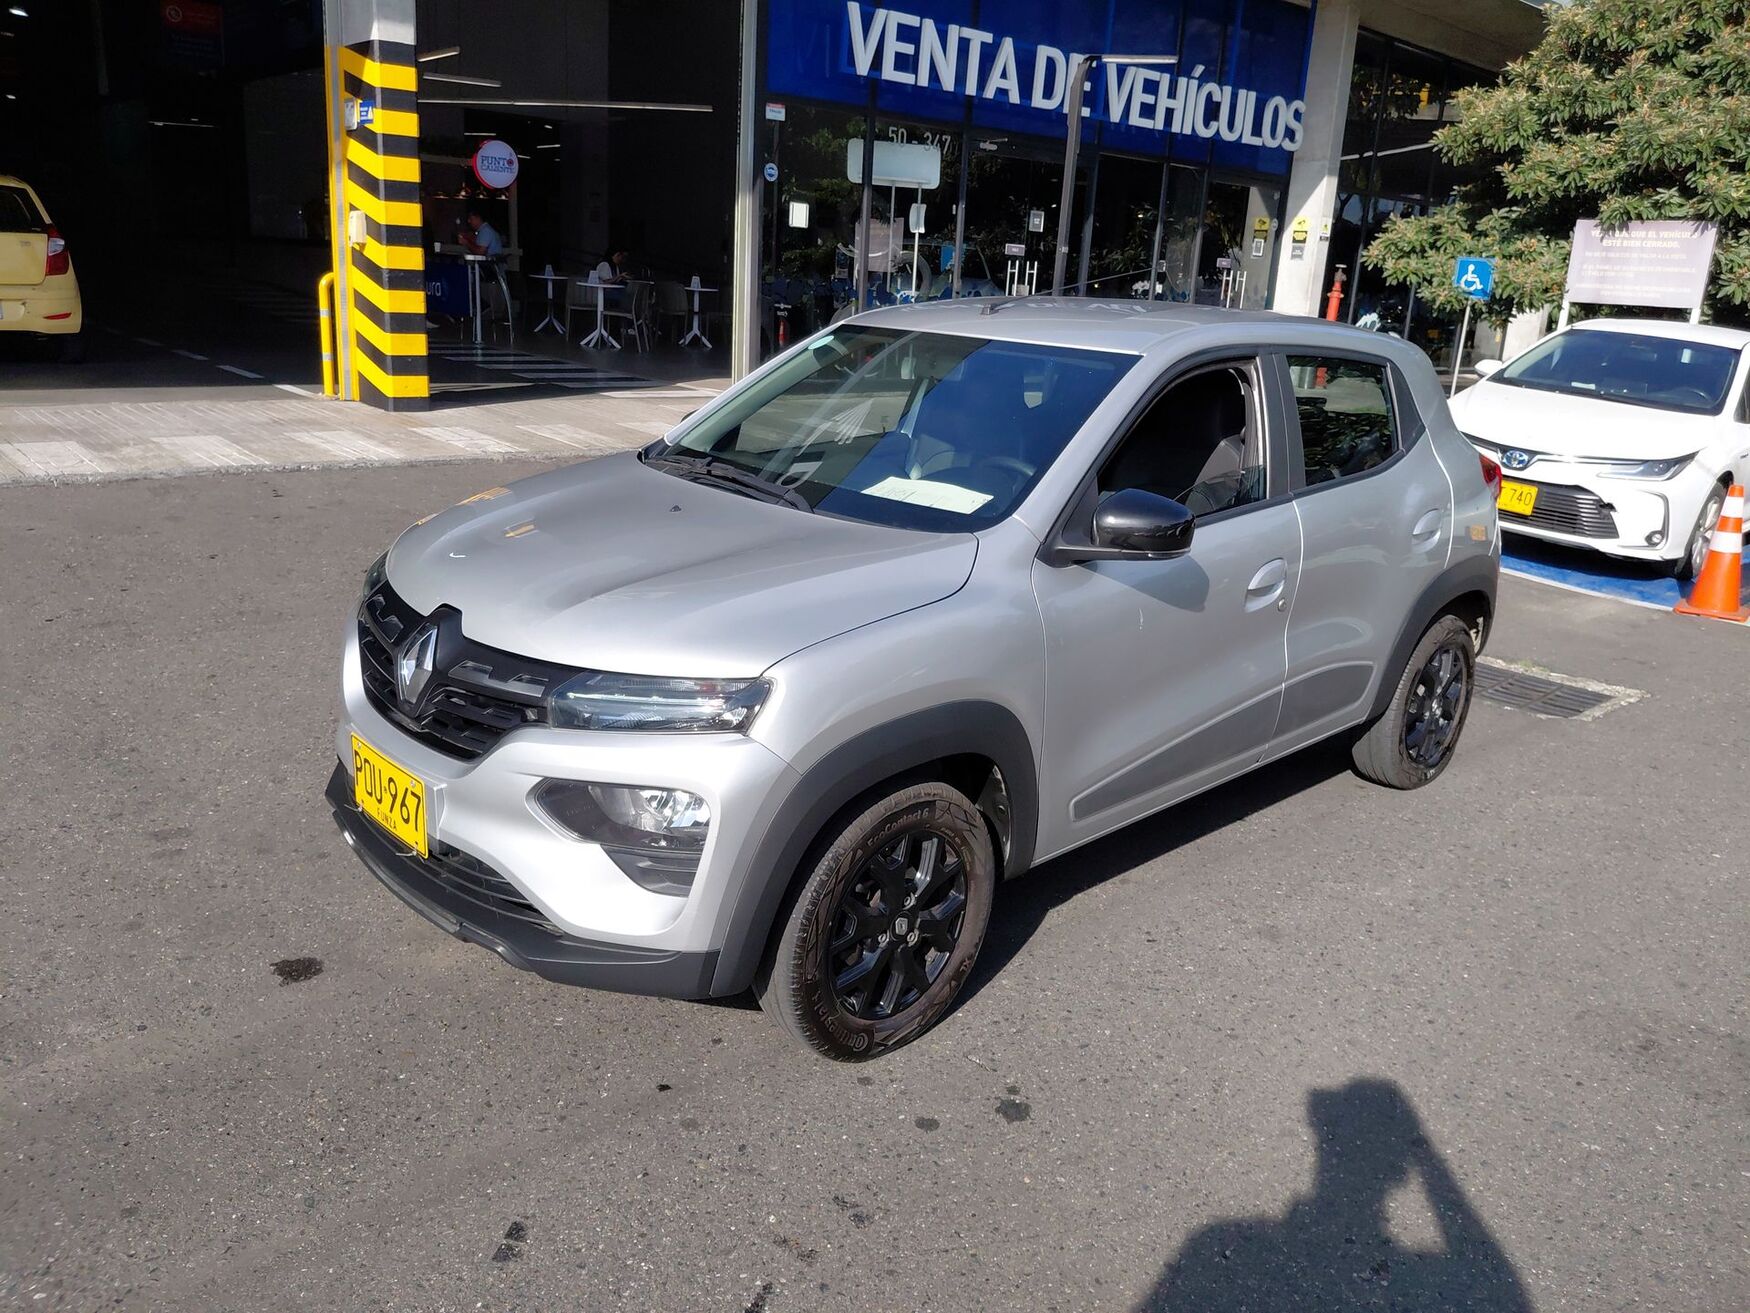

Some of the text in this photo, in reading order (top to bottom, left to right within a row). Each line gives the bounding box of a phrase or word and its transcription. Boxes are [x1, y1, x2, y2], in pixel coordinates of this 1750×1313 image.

[847, 1, 1306, 151] VENTA DE VEHÍCULOS
[888, 126, 907, 148] 50
[1510, 488, 1533, 506] 740
